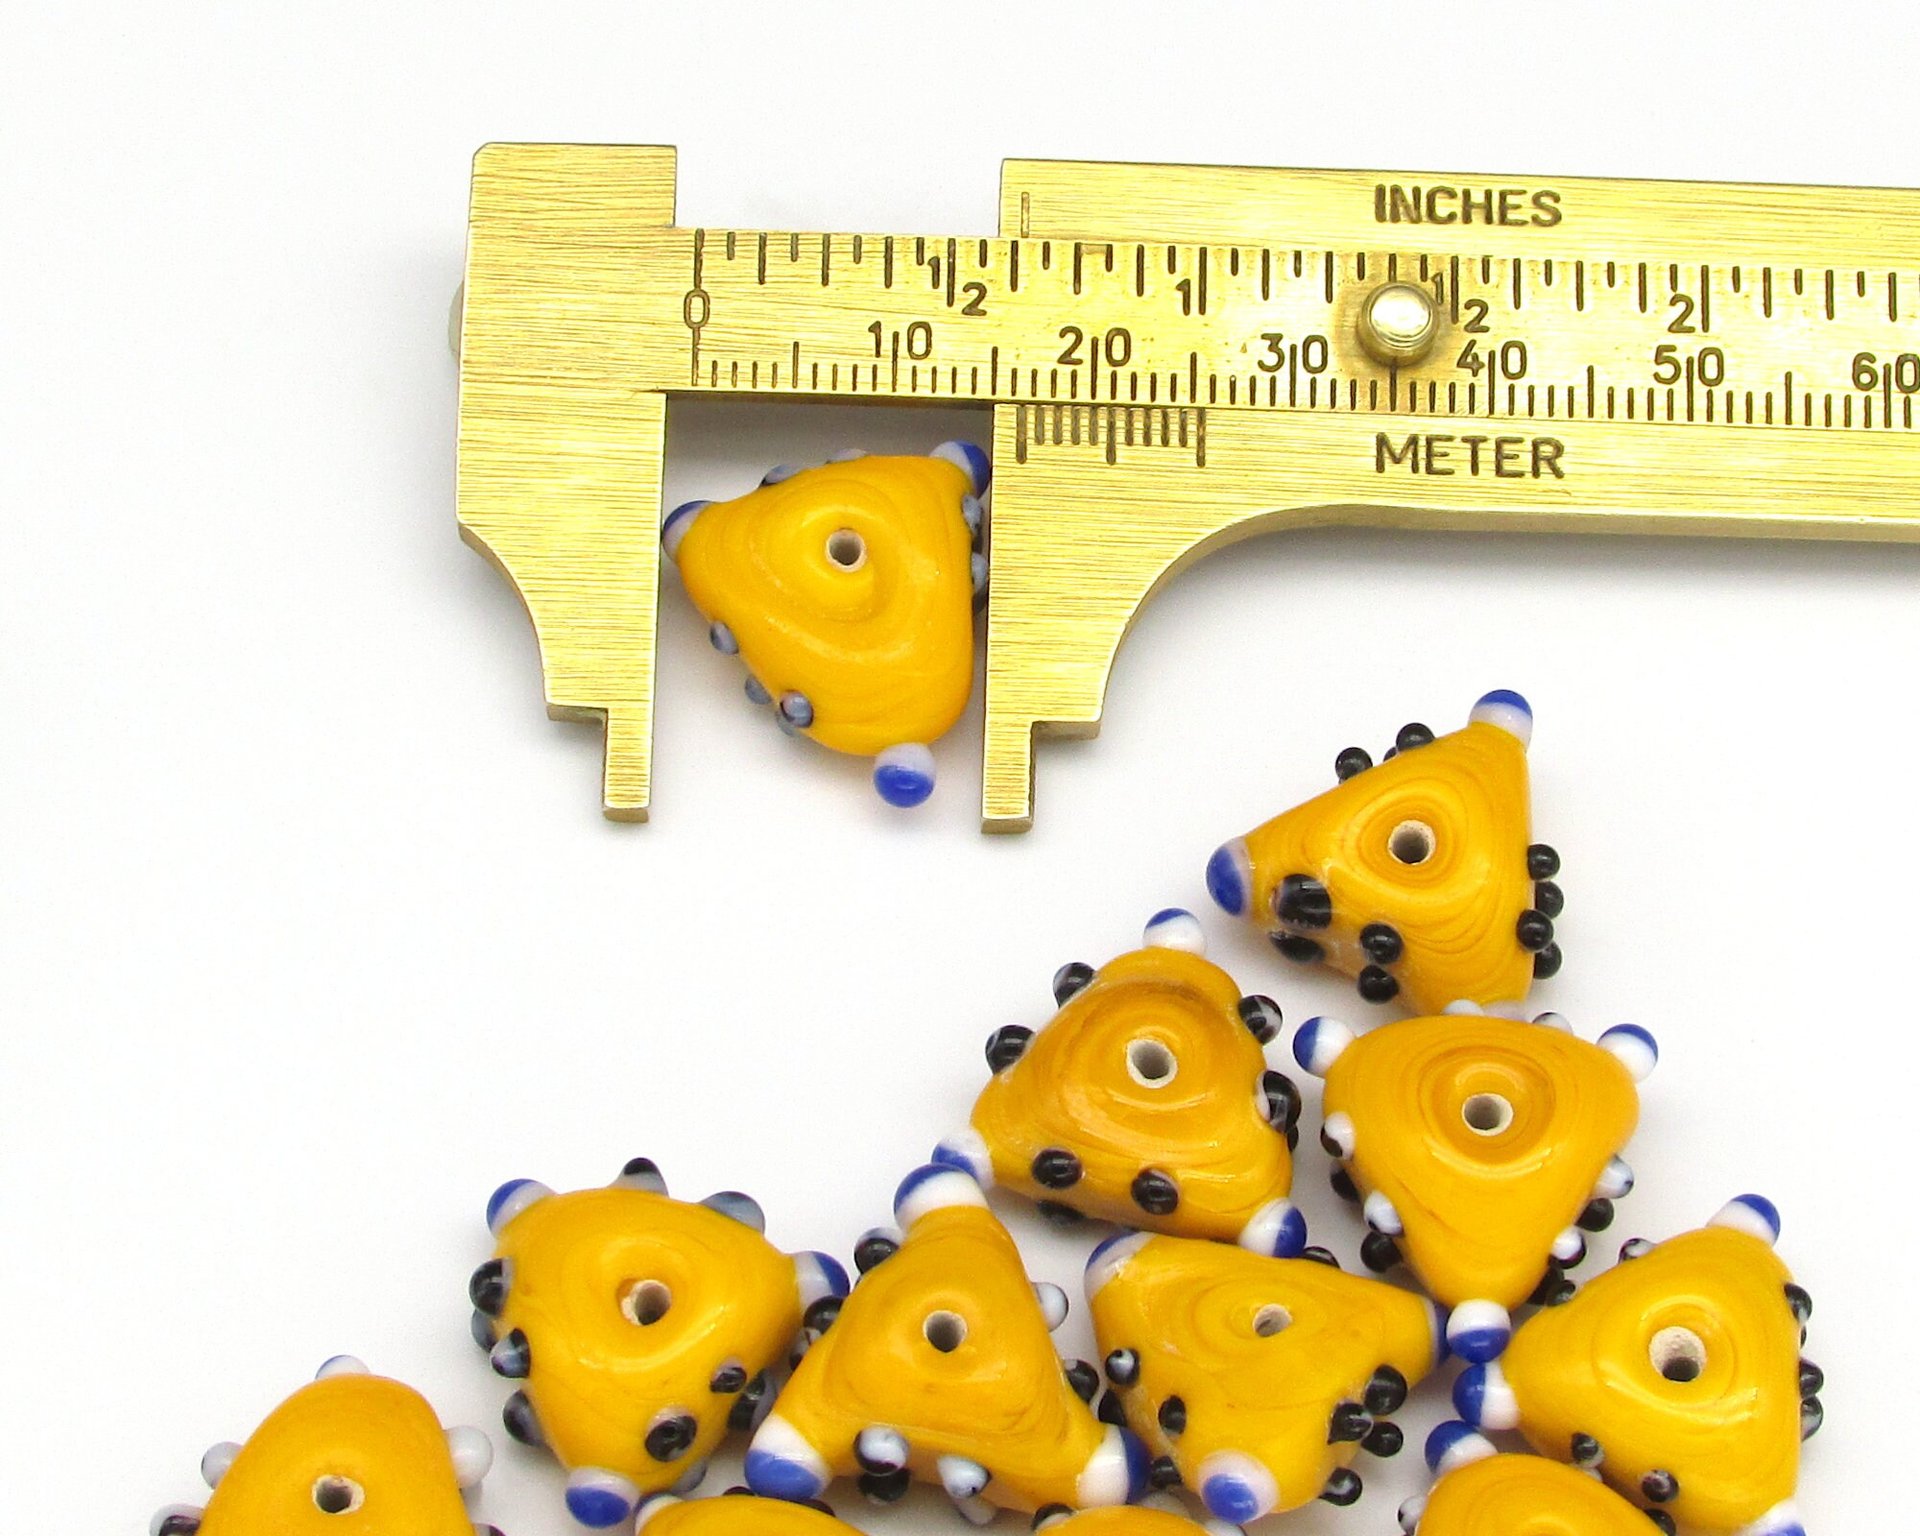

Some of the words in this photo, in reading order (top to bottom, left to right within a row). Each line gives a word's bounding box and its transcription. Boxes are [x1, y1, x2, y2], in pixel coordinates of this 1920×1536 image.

[1374, 184, 1562, 227] INCHES
[683, 288, 710, 328] 0
[1668, 293, 1696, 333] 2
[1375, 432, 1565, 479] METER
